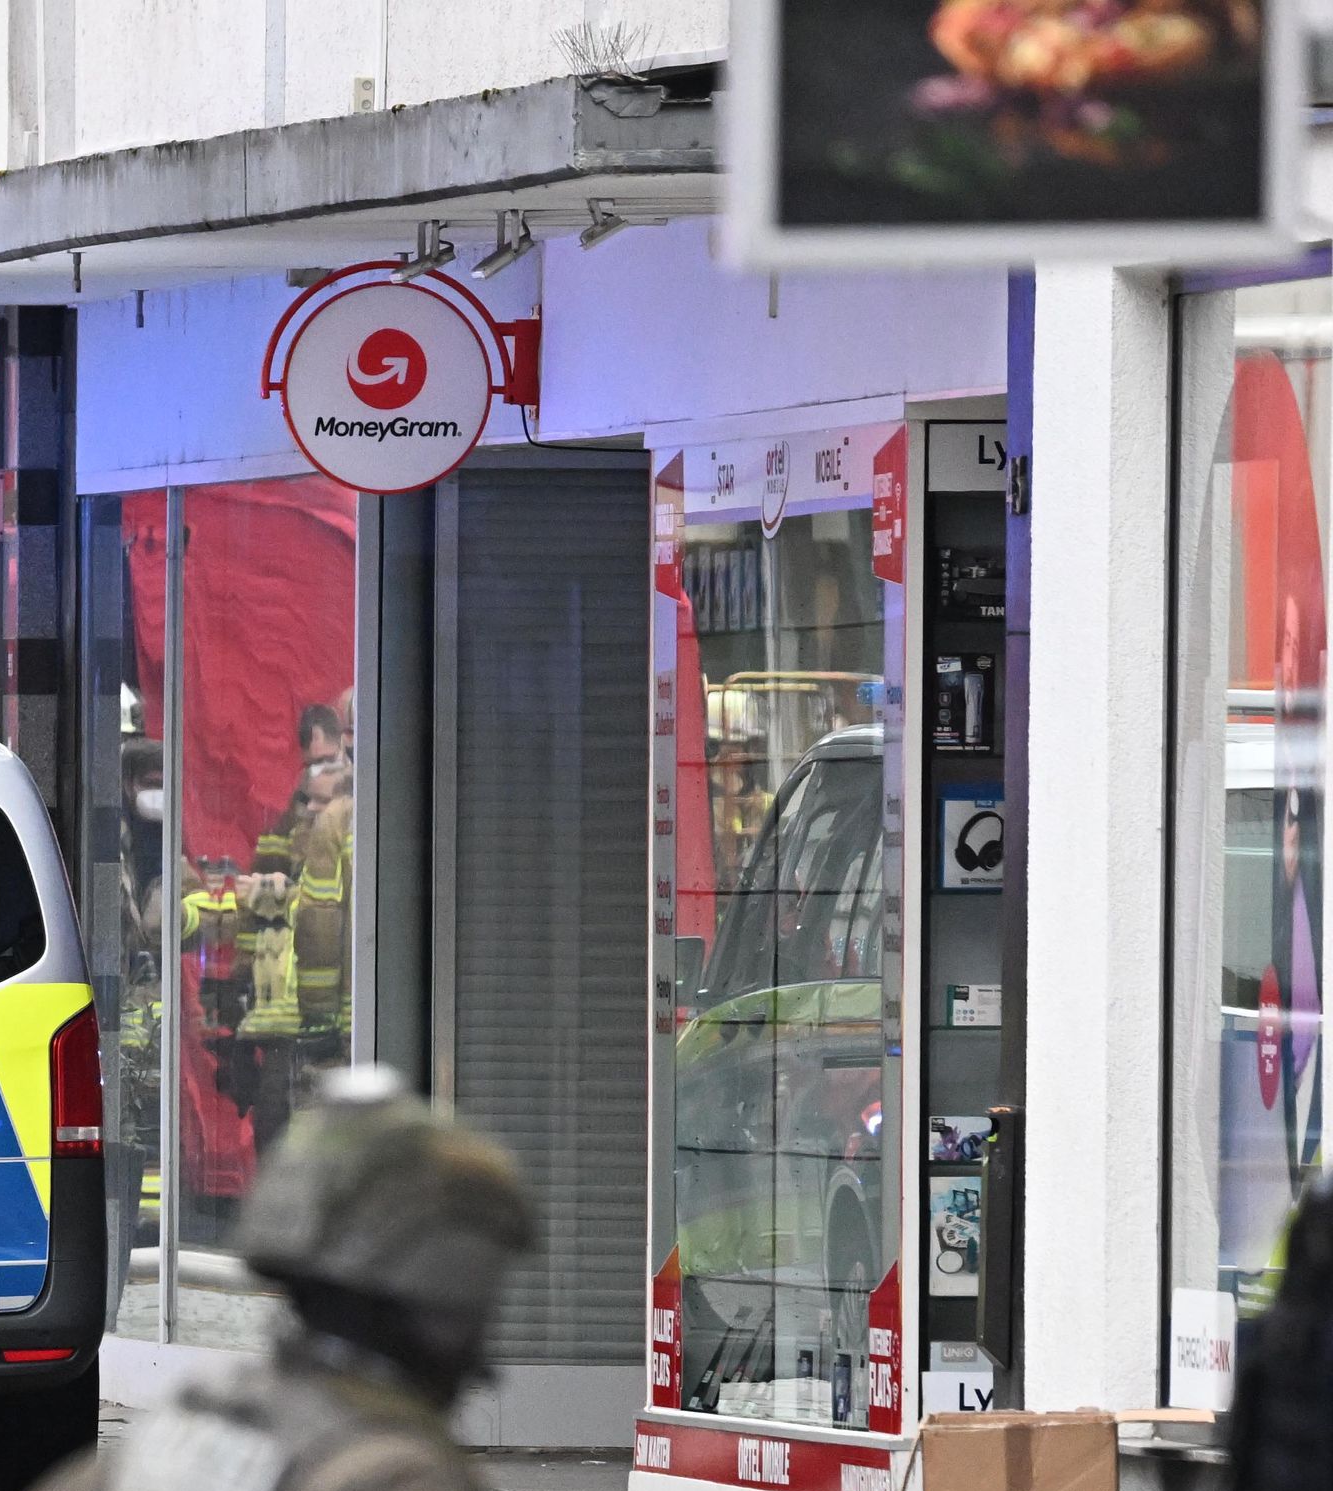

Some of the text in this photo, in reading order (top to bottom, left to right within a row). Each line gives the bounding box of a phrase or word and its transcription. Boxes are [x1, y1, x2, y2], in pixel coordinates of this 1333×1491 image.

[314, 416, 460, 442] MoneyGram
[766, 441, 785, 475] ortel
[815, 448, 842, 484] MOBILE
[761, 1440, 790, 1486] MOBILE
